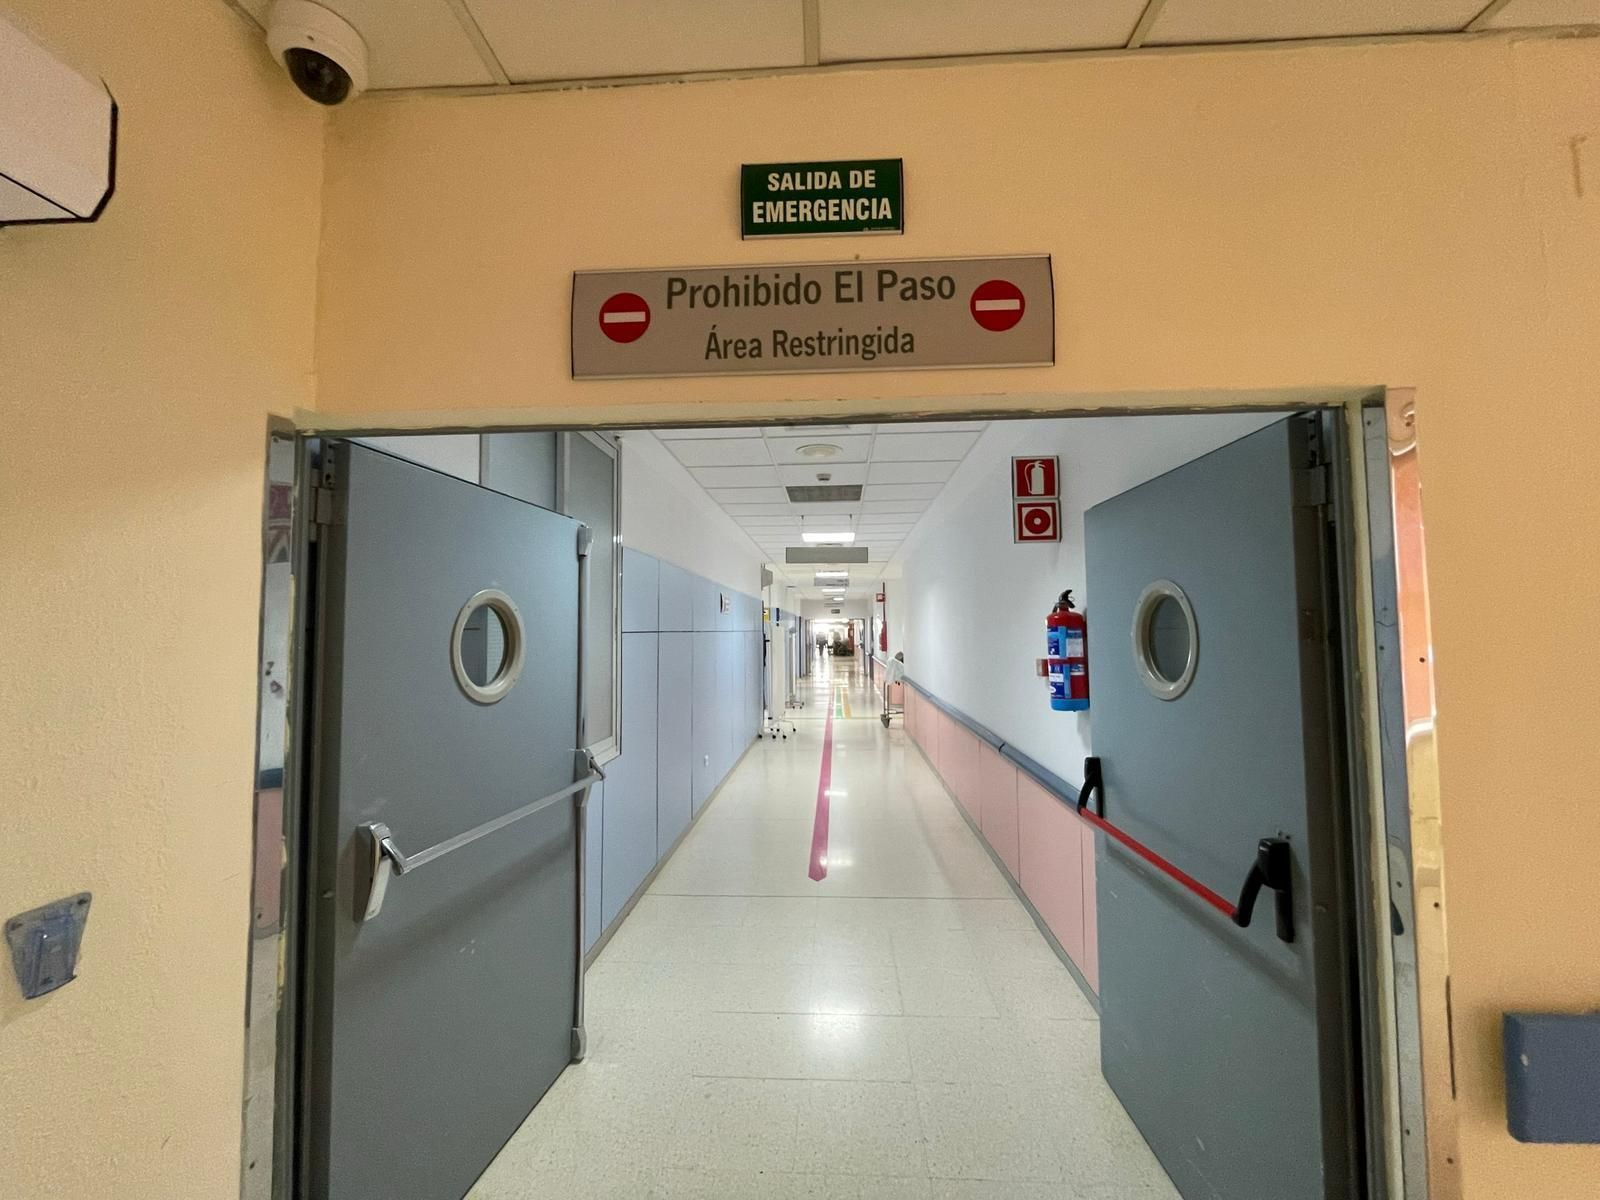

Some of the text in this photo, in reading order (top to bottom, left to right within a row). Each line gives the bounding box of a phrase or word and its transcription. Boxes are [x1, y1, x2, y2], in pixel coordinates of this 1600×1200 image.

[767, 169, 876, 191] SALIDA DE
[752, 197, 892, 224] EMERGENCIA
[666, 269, 956, 309] Prohibido El Paso
[705, 324, 915, 361] Área Restringida
